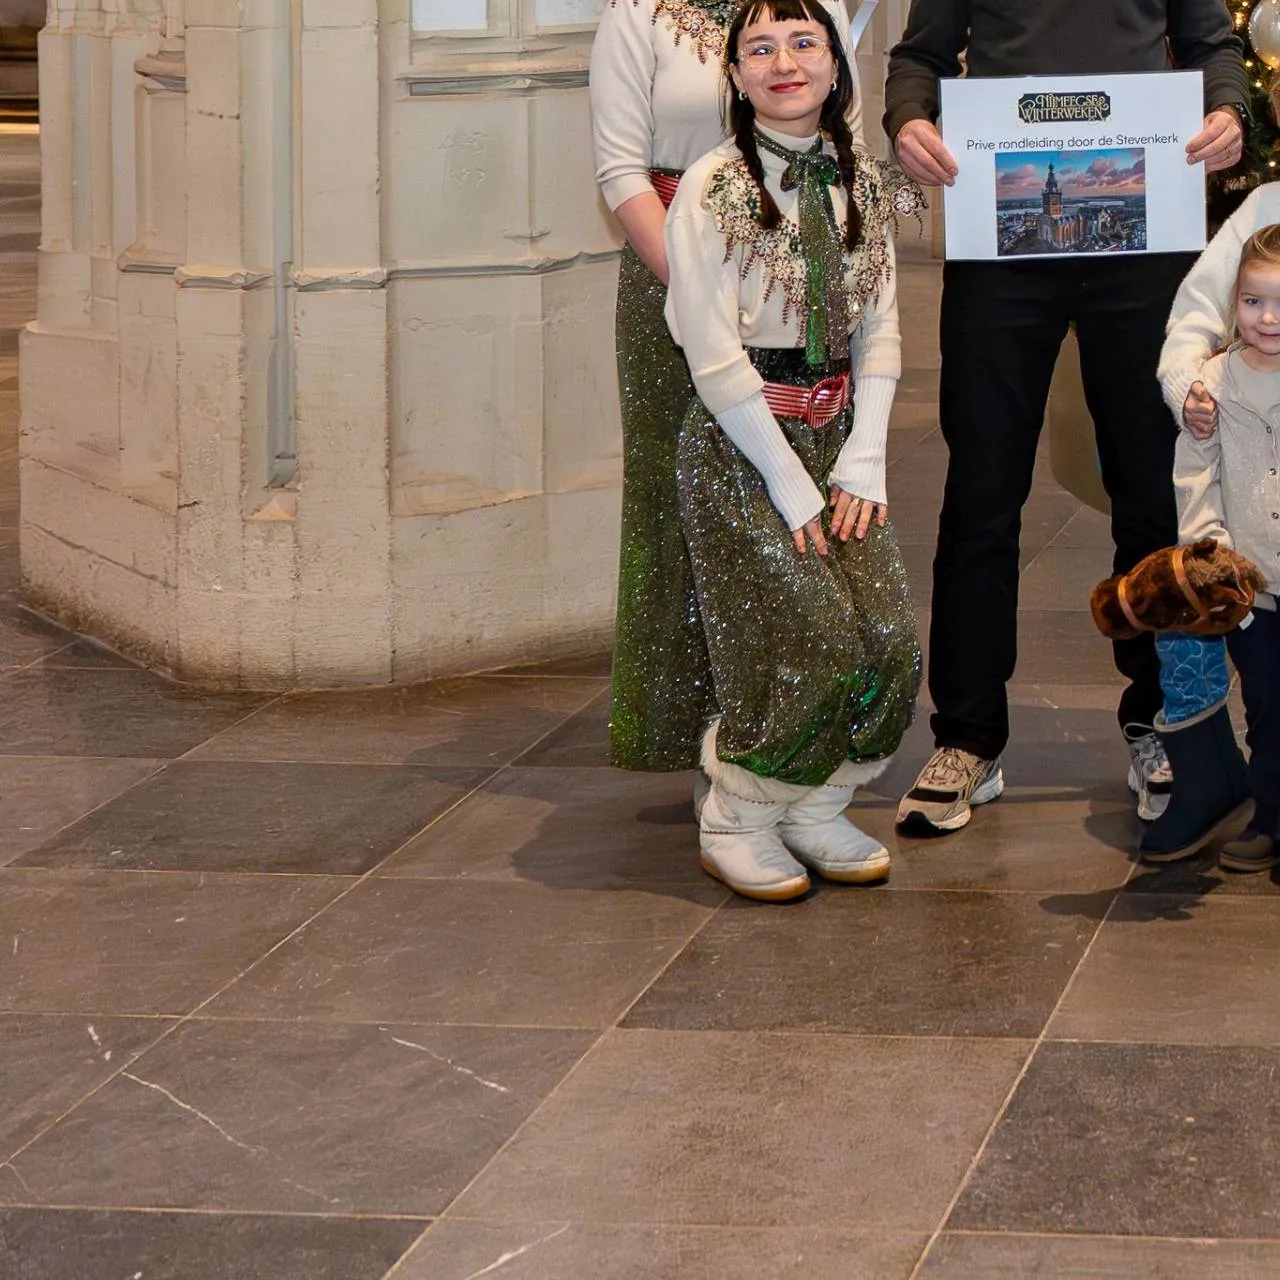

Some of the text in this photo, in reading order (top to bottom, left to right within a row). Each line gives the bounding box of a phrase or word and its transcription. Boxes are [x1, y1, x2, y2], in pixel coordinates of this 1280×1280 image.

[1036, 93, 1105, 109] NIJMEEGSE
[1019, 105, 1104, 121] WINTERWEKEN
[967, 133, 1179, 151] Prive rondleiding door de Stevenkerk
